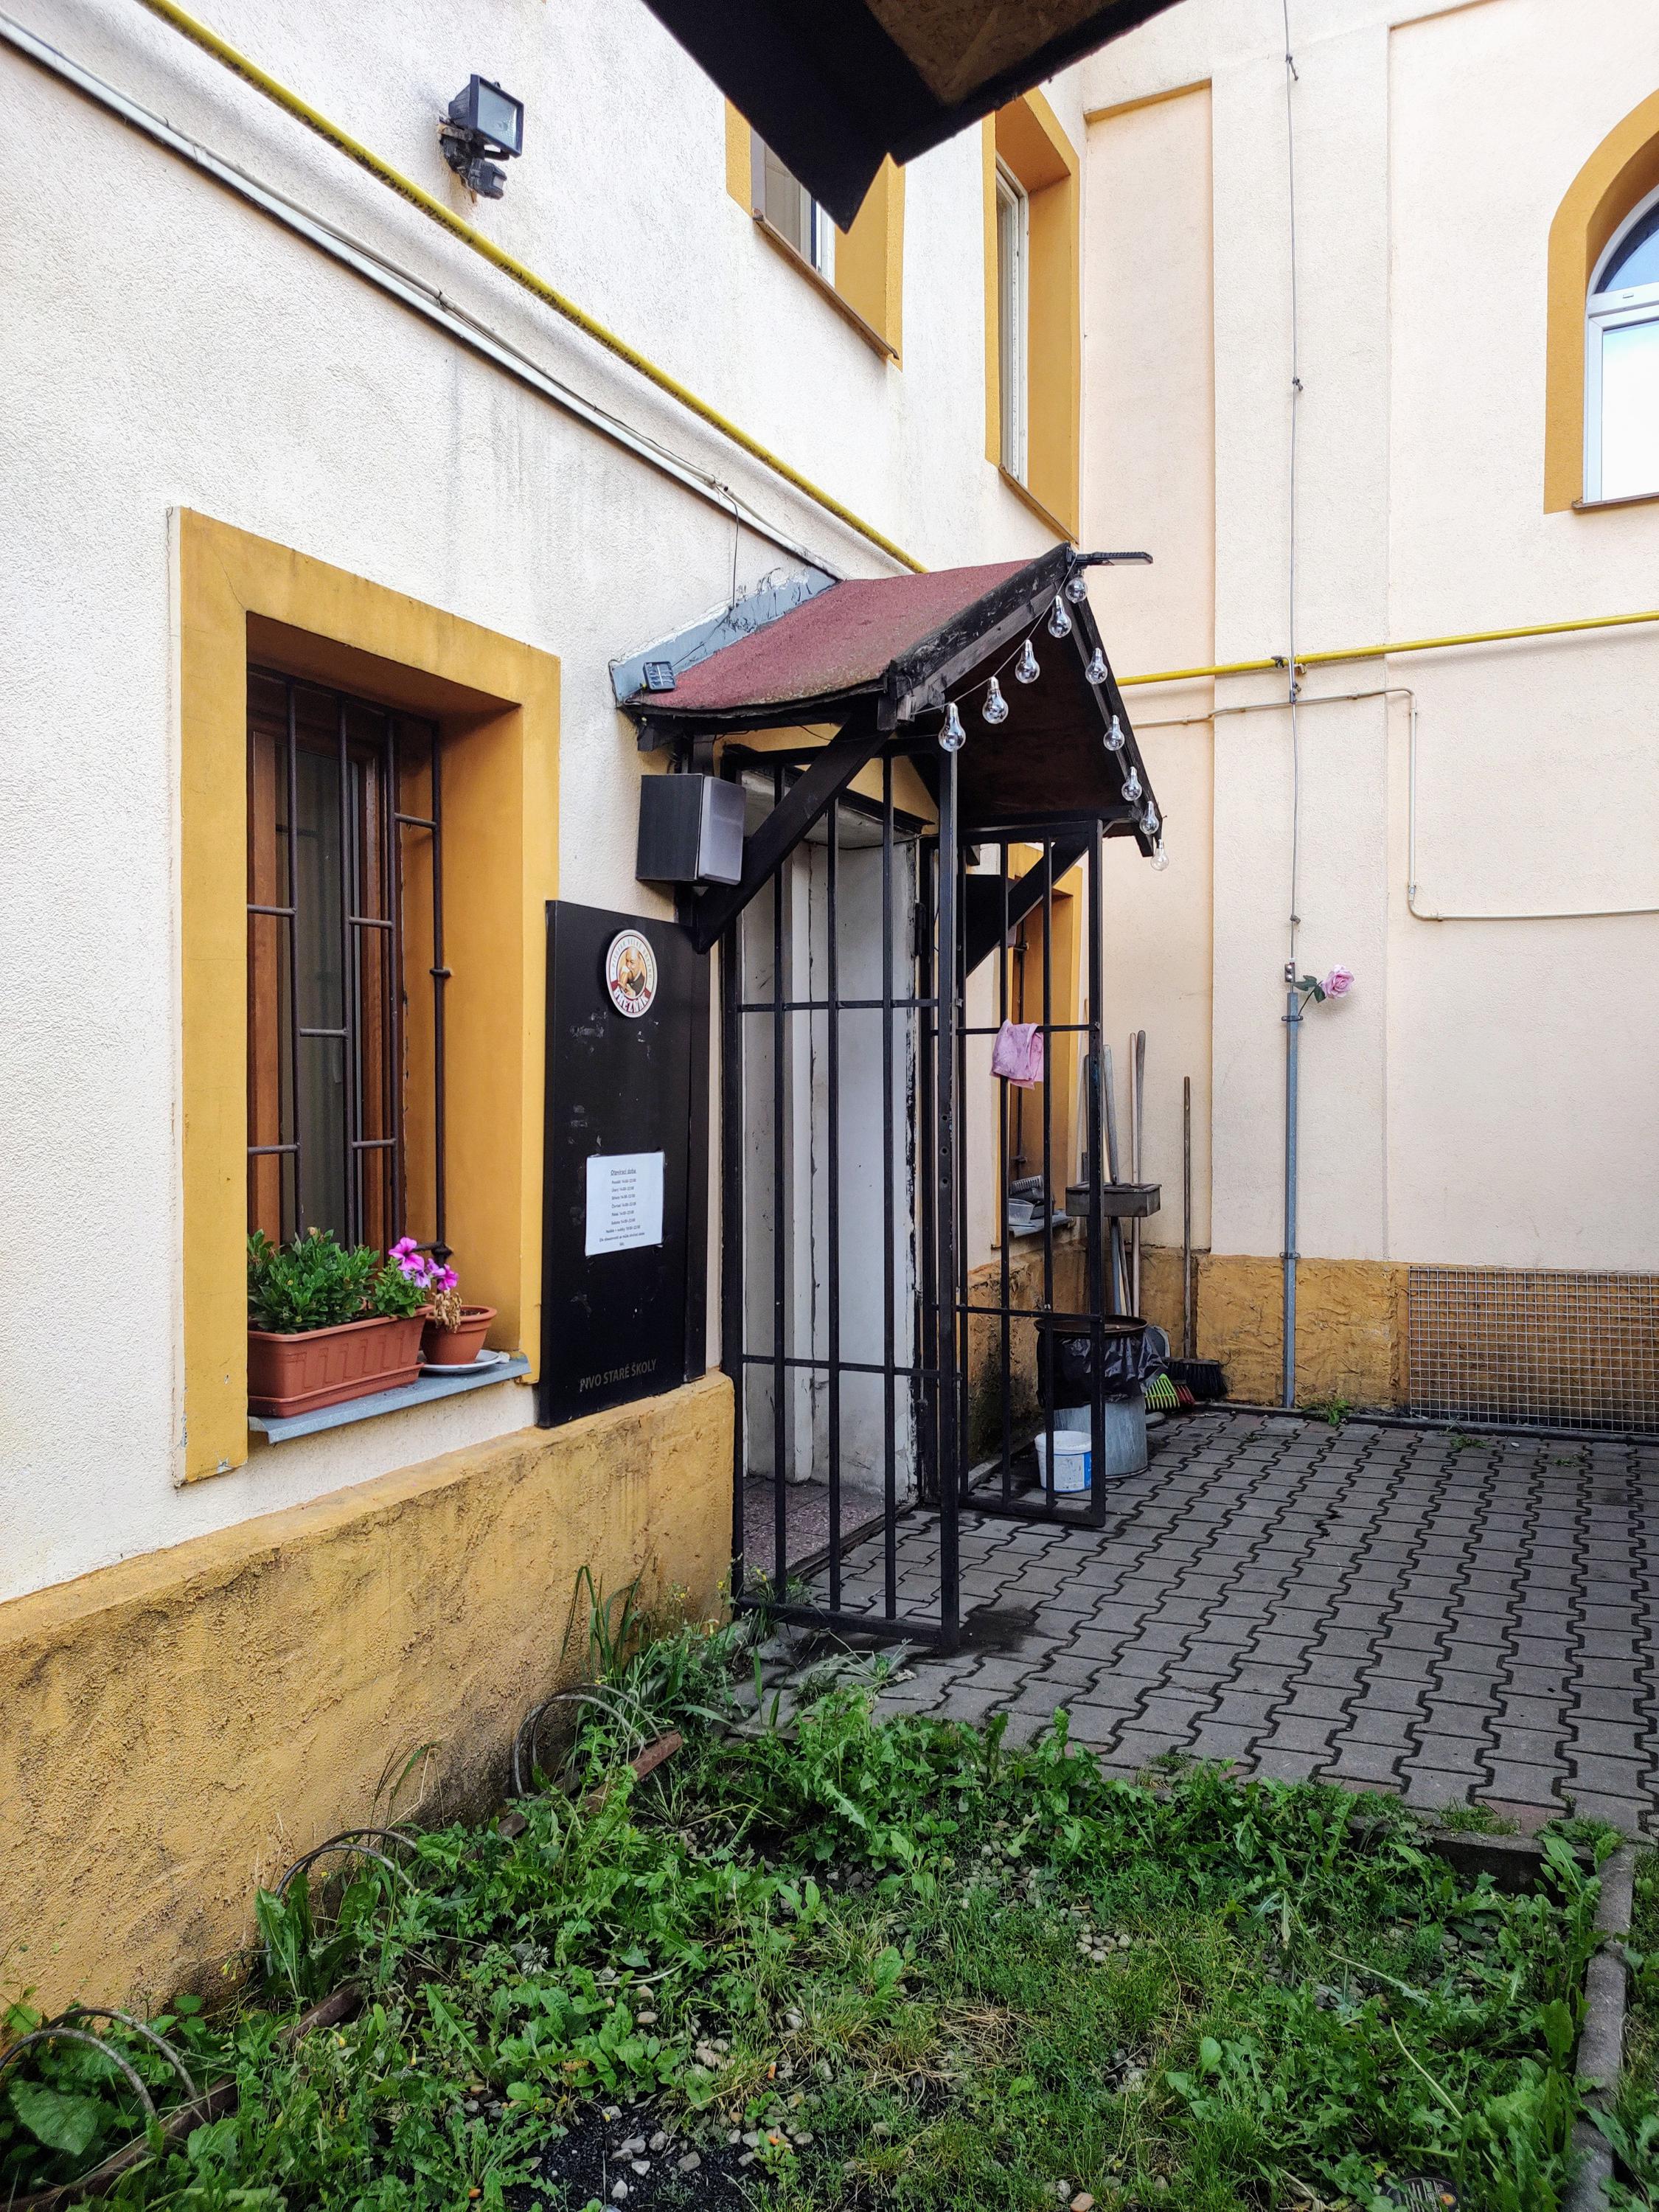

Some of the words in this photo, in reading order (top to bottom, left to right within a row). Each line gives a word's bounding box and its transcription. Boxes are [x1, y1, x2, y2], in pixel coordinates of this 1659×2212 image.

[580, 1374, 602, 1392] PIVO
[603, 1364, 630, 1385] STARÉ
[631, 1358, 656, 1377] ŠKOLY
